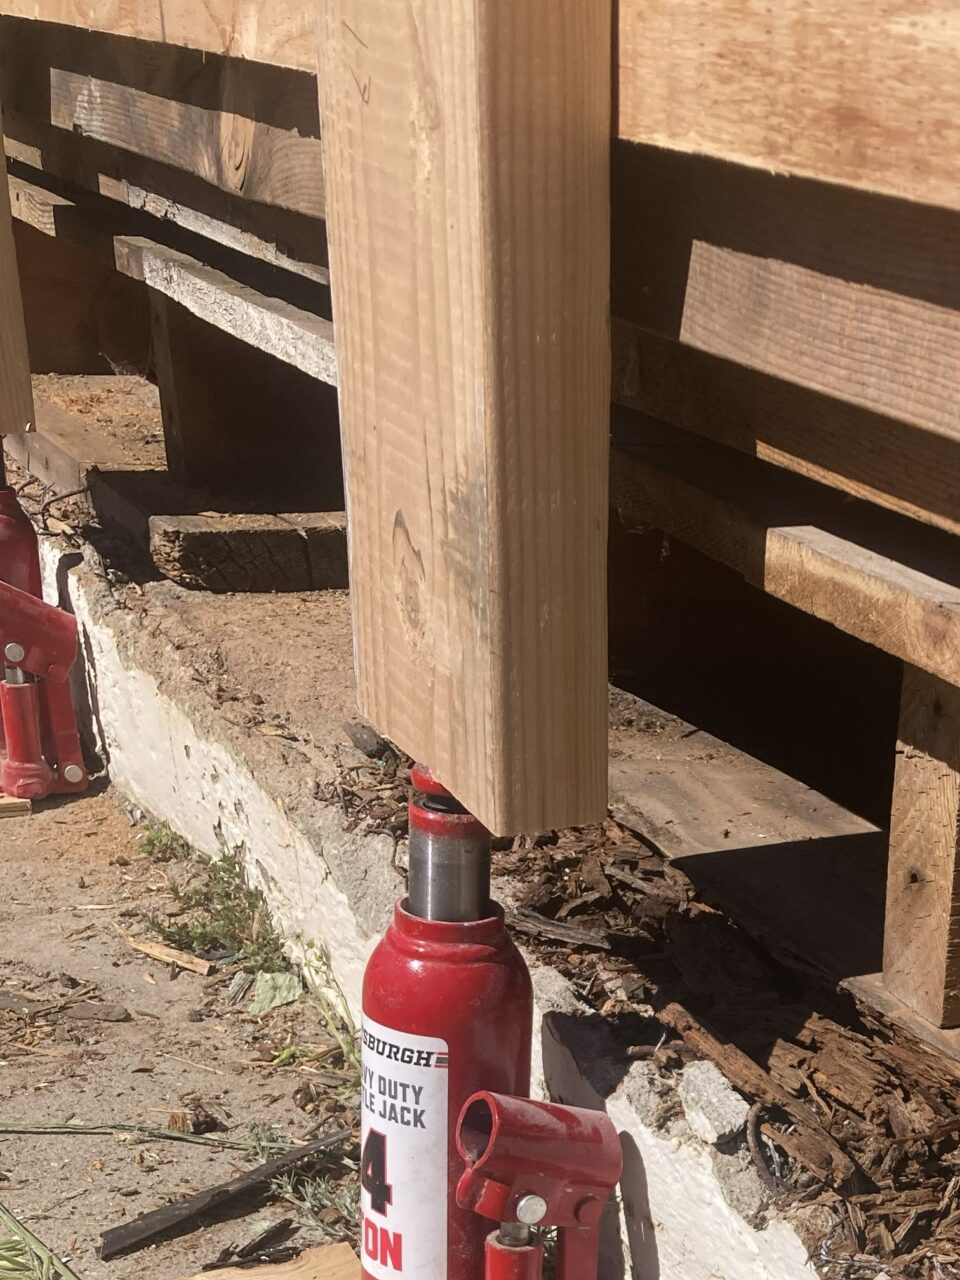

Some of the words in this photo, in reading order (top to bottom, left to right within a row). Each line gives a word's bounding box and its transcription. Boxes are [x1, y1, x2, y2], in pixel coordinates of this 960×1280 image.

[362, 1026, 435, 1068] SBURGH
[378, 1074, 424, 1106] DUTY
[378, 1099, 426, 1129] JACK
[361, 1127, 393, 1217] 4
